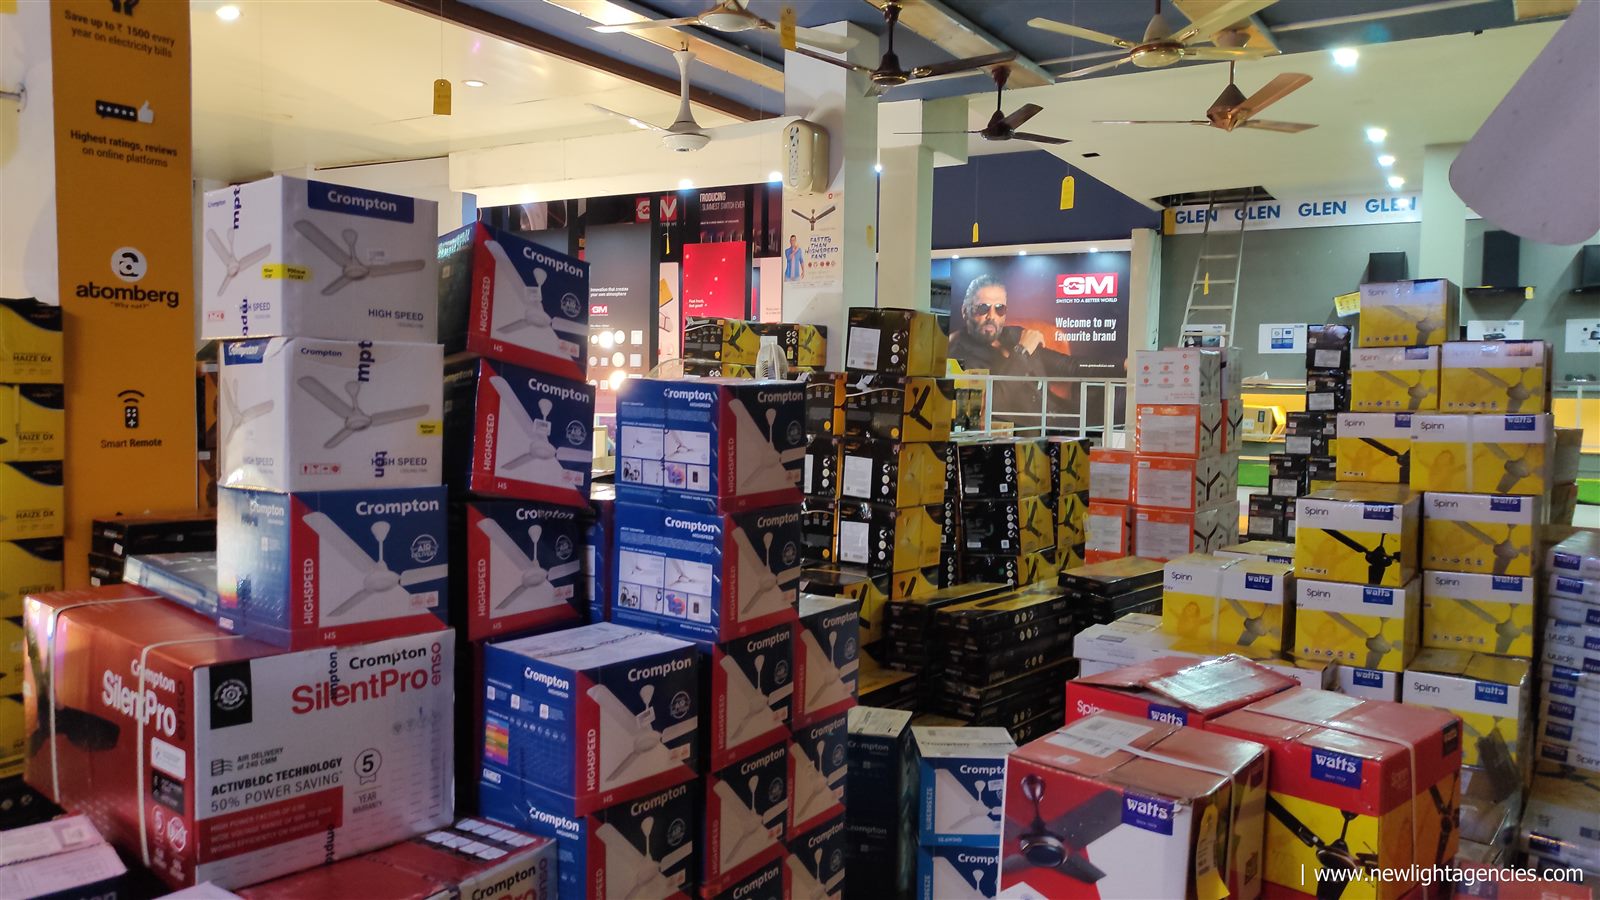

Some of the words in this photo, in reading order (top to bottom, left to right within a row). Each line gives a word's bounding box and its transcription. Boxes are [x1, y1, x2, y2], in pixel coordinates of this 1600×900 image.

[64, 10, 88, 24] Save
[90, 18, 103, 29] up
[105, 20, 115, 30] to
[127, 26, 150, 40] 1500
[152, 33, 176, 48] every
[72, 26, 92, 38] year
[94, 32, 106, 42] on
[108, 35, 152, 56] electricity
[154, 46, 173, 58] bills
[70, 130, 108, 144] Highest
[109, 138, 144, 152] ratings,
[145, 144, 178, 156] reviews
[82, 147, 94, 156] on
[96, 149, 124, 160] online
[126, 153, 168, 168] platforms
[327, 190, 397, 212] Crompton
[1175, 209, 1218, 224] GLEN
[1234, 204, 1281, 220] GLEN
[1298, 200, 1348, 217] GLEN
[1365, 196, 1417, 214] GLEN
[522, 246, 584, 278] Crompton
[1058, 275, 1114, 296] GM
[76, 281, 180, 308] atomberg
[480, 276, 490, 332] HIGHSPEED
[592, 306, 608, 314] GM
[368, 308, 392, 318] HIGH
[394, 310, 424, 321] SPEED
[1055, 317, 1092, 328] Welcome
[1093, 318, 1102, 328] to
[1104, 319, 1117, 330] my
[1055, 330, 1090, 342] favourite
[1092, 330, 1117, 342] brand
[300, 347, 342, 358] Crompton
[493, 344, 503, 352] HS
[358, 340, 376, 382] mpt
[528, 378, 590, 404] Crompton
[663, 388, 713, 402] Crompton
[757, 391, 804, 404] Crompton
[1344, 418, 1366, 428] Spinn
[1420, 421, 1446, 432] Spinn
[100, 439, 128, 448] Smart
[129, 438, 162, 448] Remote
[484, 413, 495, 470] HIGHSPEED
[398, 458, 428, 466] SPEED
[498, 482, 508, 490] HS
[250, 500, 285, 517] Crompton
[355, 498, 440, 517] Crompton
[1304, 506, 1330, 517] Spinn
[1433, 499, 1459, 510] Spinn
[516, 508, 575, 520] Crompton
[757, 513, 799, 528] Crompton
[664, 516, 716, 534] Crompton
[410, 550, 438, 560] DELIVERY
[418, 544, 432, 552] AIR
[1171, 571, 1193, 582] Spinn
[1248, 575, 1270, 584] watts
[1435, 576, 1460, 587] Spinn
[304, 558, 314, 625] HIGHSPEED
[478, 558, 486, 616] HIGHSPEED
[1306, 588, 1332, 599] Spinn
[1365, 588, 1391, 598] watts
[822, 611, 858, 629] Crompton
[324, 631, 336, 640] HS
[746, 630, 790, 653] Crompton
[1548, 632, 1576, 645] Spinn
[349, 646, 427, 670] Crompton
[430, 642, 442, 686] enso
[1547, 652, 1575, 665] Spinn
[524, 666, 570, 690] Crompton
[628, 658, 692, 682] Crompton
[1355, 670, 1380, 681] watts
[292, 668, 428, 715] SilentPro
[1414, 681, 1440, 694] Spinn
[1478, 685, 1504, 696] watts
[1151, 710, 1184, 726] watts
[810, 716, 846, 740] Crompton
[237, 754, 250, 763] AIR
[251, 747, 284, 760] DELIVERY
[238, 763, 244, 771] of
[260, 756, 278, 766] CMM
[362, 754, 374, 773] 5
[586, 728, 596, 792] HIGHSPEED
[740, 748, 785, 776] Crompton
[276, 757, 343, 781] TECHNOLOGY
[1315, 754, 1357, 774] watts
[211, 796, 240, 812] 50%
[244, 784, 291, 805] POWER
[358, 792, 377, 804] YEAR
[603, 794, 614, 804] HS
[630, 784, 687, 817] Crompton
[352, 800, 383, 814] WARRANTY
[1126, 798, 1169, 820] watts
[529, 806, 580, 832] Crompton
[808, 822, 844, 848] Crompton
[472, 866, 536, 900] Crompton
[732, 866, 780, 900] Crompton
